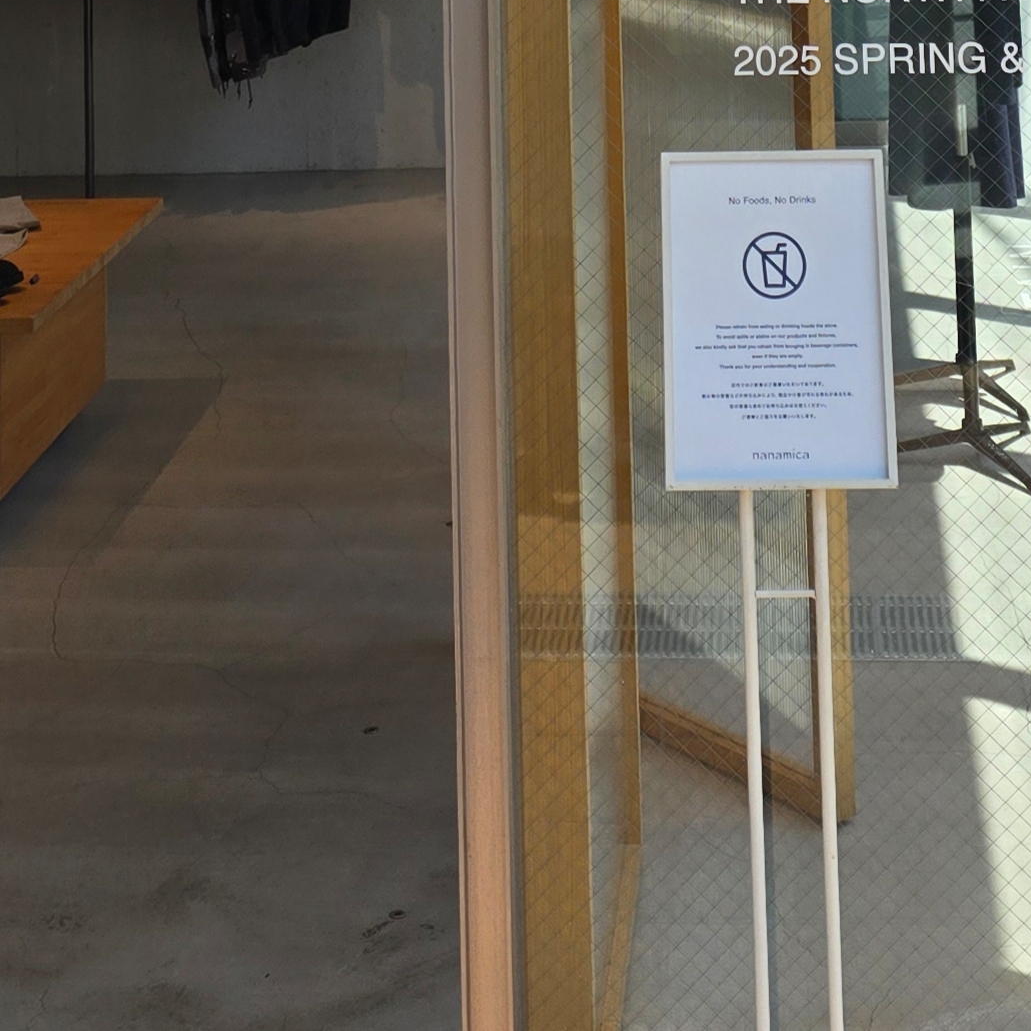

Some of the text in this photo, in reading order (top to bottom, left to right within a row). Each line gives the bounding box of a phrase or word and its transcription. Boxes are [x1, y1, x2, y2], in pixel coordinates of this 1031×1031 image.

[733, 44, 822, 77] 2025
[834, 41, 987, 76] SPRING
[1000, 40, 1024, 74] &
[728, 195, 816, 205] No Foods, No Drinks
[752, 448, 810, 461] nanamica
